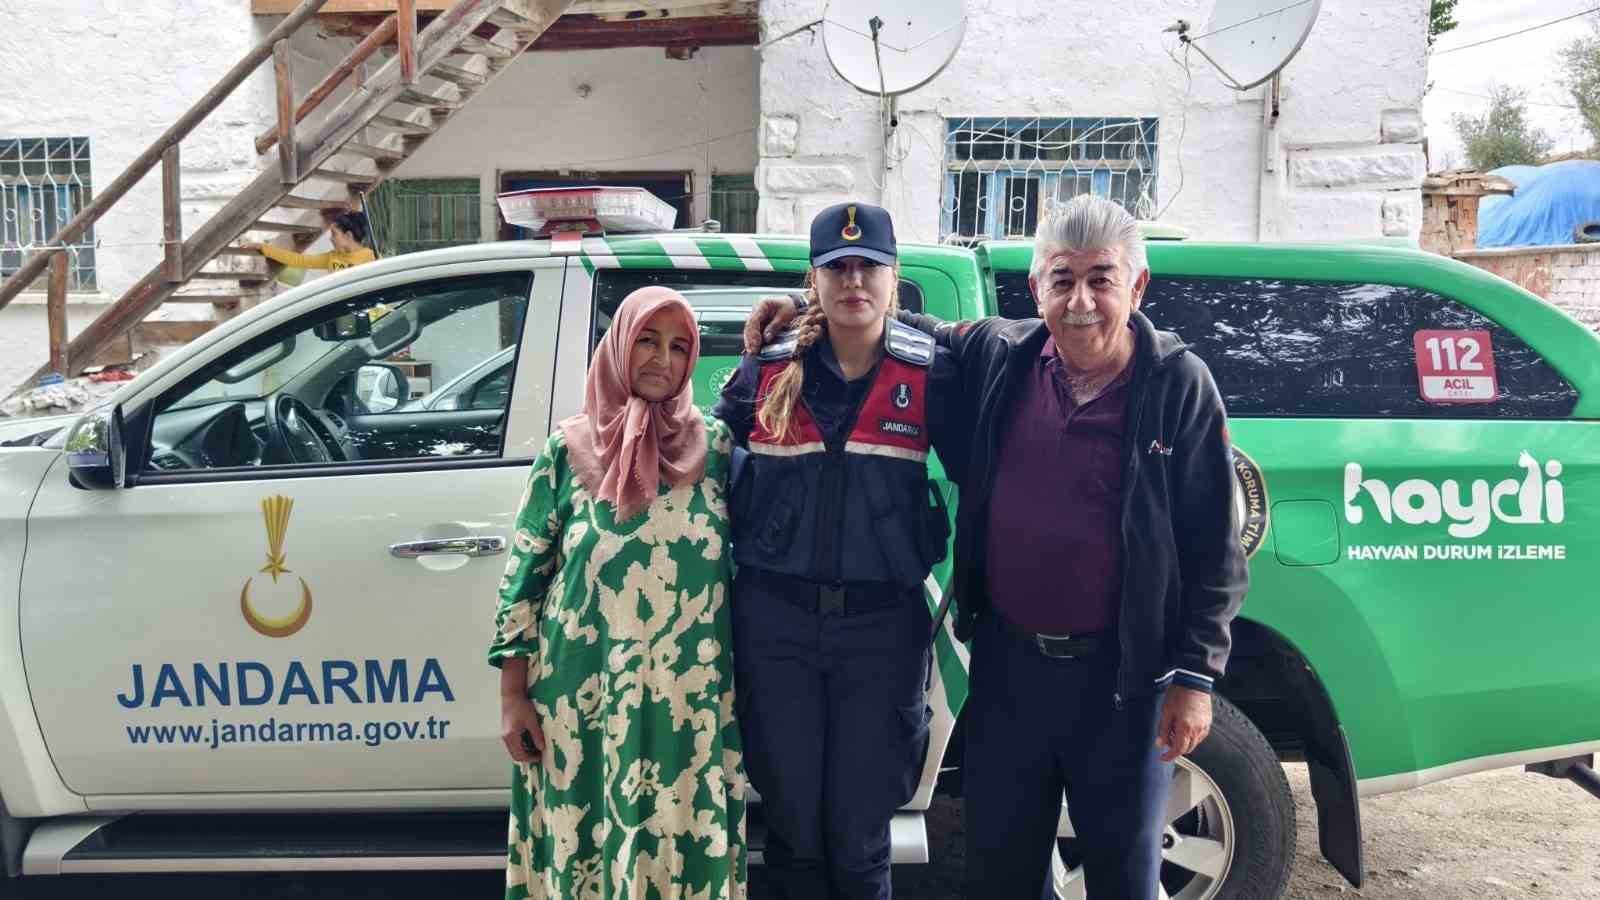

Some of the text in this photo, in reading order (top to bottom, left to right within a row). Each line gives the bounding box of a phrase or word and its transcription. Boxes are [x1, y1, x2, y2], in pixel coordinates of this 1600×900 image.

[1425, 337, 1484, 370] 112
[1237, 462, 1261, 518] KORUMA
[1344, 449, 1564, 538] haydi
[1348, 545, 1417, 560] HAYVAN
[1424, 545, 1492, 560] DURUM
[117, 658, 455, 709] JANDARMA
[126, 716, 450, 748] www.jandarma.gov.tr
